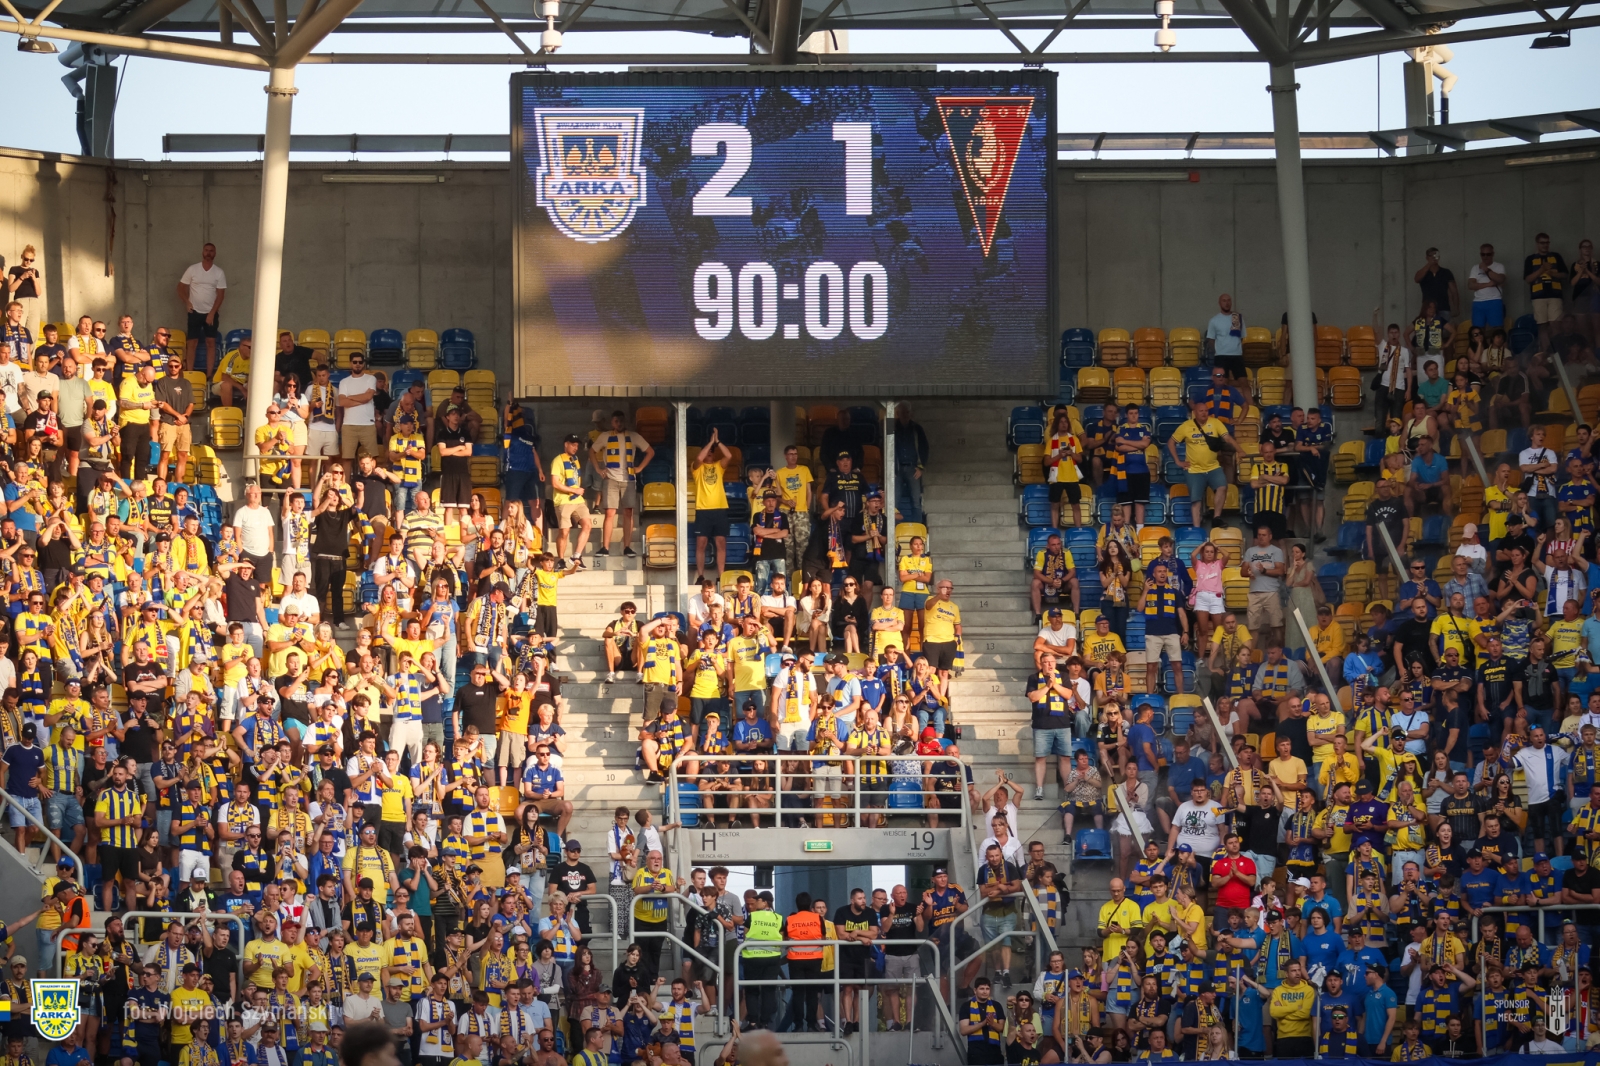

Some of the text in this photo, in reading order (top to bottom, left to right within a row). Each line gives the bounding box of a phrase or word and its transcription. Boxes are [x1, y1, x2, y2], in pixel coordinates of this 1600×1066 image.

[691, 122, 873, 216] 2 1
[557, 181, 626, 195] ARKA
[693, 261, 889, 340] 90:00
[968, 516, 977, 524] 16
[592, 560, 601, 568] 15
[974, 560, 983, 568] 15
[595, 602, 604, 610] 14
[979, 600, 989, 608] 14
[986, 642, 995, 651] 13
[1093, 643, 1116, 654] ARKA
[601, 687, 610, 695] 12
[991, 685, 1000, 693] 12
[603, 731, 612, 739] 11
[997, 728, 1006, 737] 11
[606, 773, 615, 781] 10
[702, 832, 716, 851] H
[911, 831, 935, 851] 19
[754, 920, 779, 928] STEWARD
[791, 921, 818, 929] STEWARD
[1281, 992, 1305, 1001] ARKA
